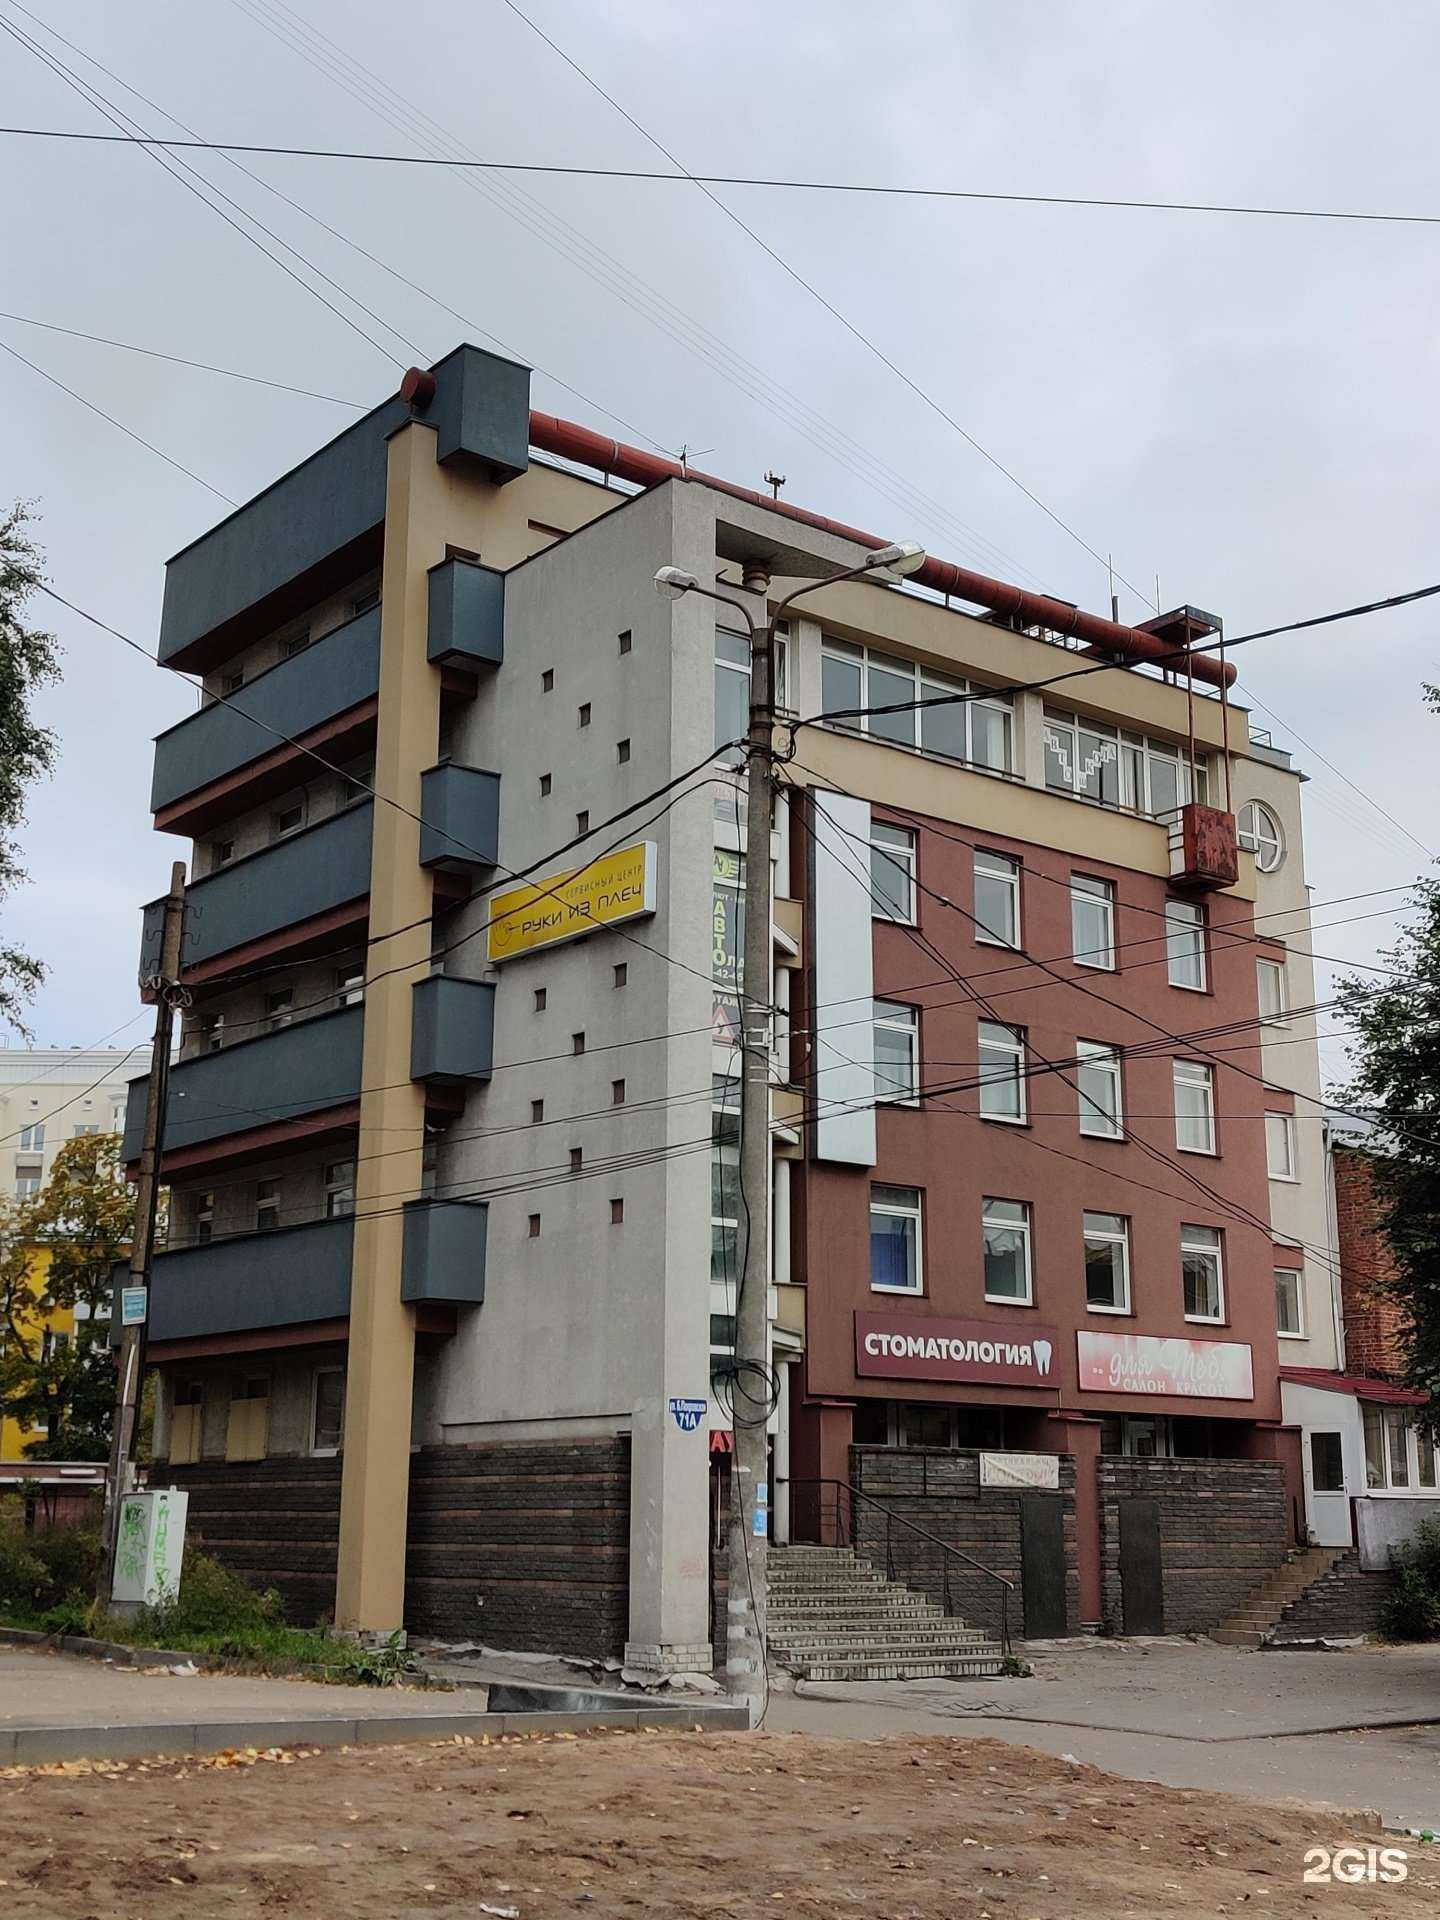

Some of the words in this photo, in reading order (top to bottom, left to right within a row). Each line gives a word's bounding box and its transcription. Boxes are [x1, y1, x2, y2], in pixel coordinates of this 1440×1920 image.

[522, 911, 563, 935] РУКИ
[568, 902, 591, 920] ИЗ
[598, 884, 642, 910] ПЛЕЧ
[864, 1333, 1033, 1366] СТОМАТОЛОГИЯ
[1123, 1378, 1167, 1393] САЛОН
